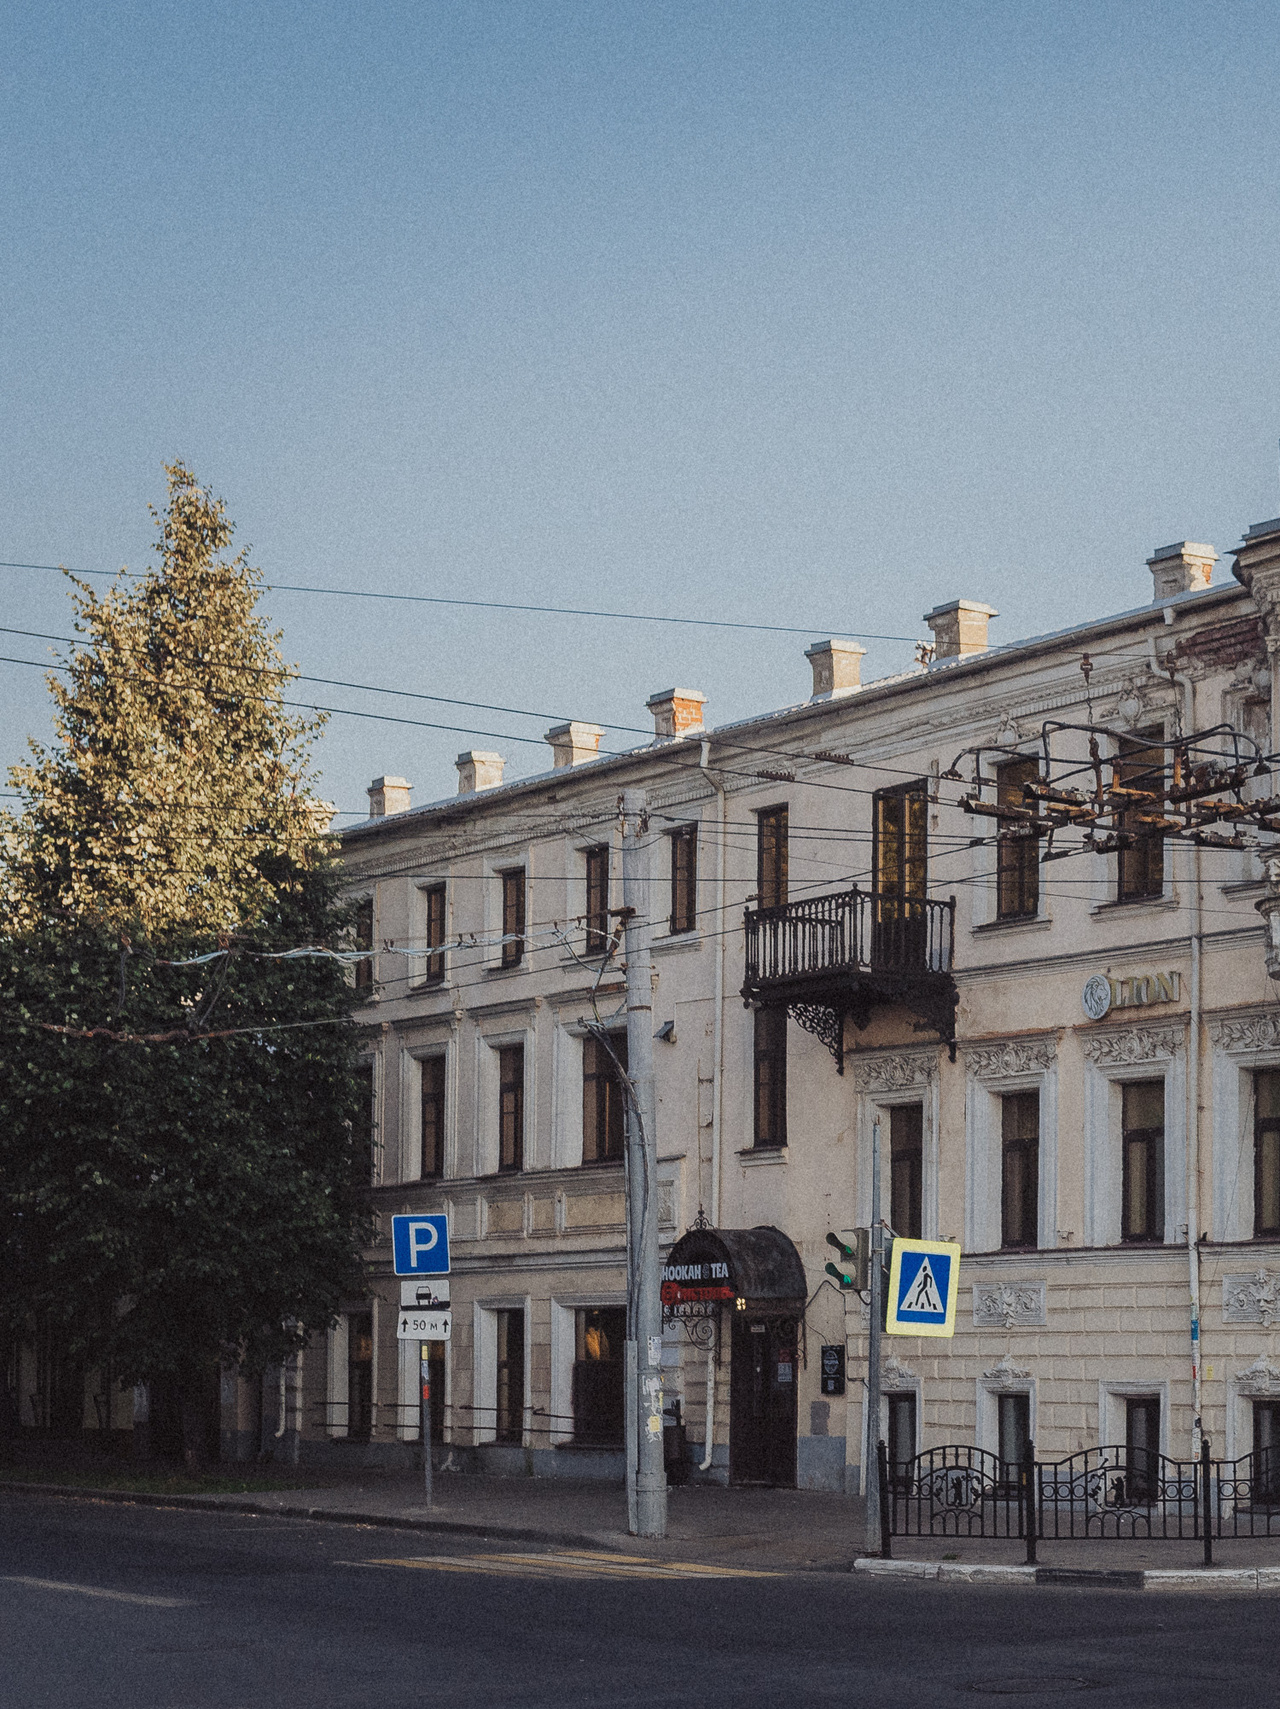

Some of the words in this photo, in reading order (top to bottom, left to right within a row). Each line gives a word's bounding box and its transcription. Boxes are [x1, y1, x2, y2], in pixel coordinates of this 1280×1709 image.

[408, 1222, 438, 1268] P
[661, 1264, 702, 1281] HOOKAH
[710, 1262, 729, 1279] TEA
[412, 1319, 427, 1331] 50
